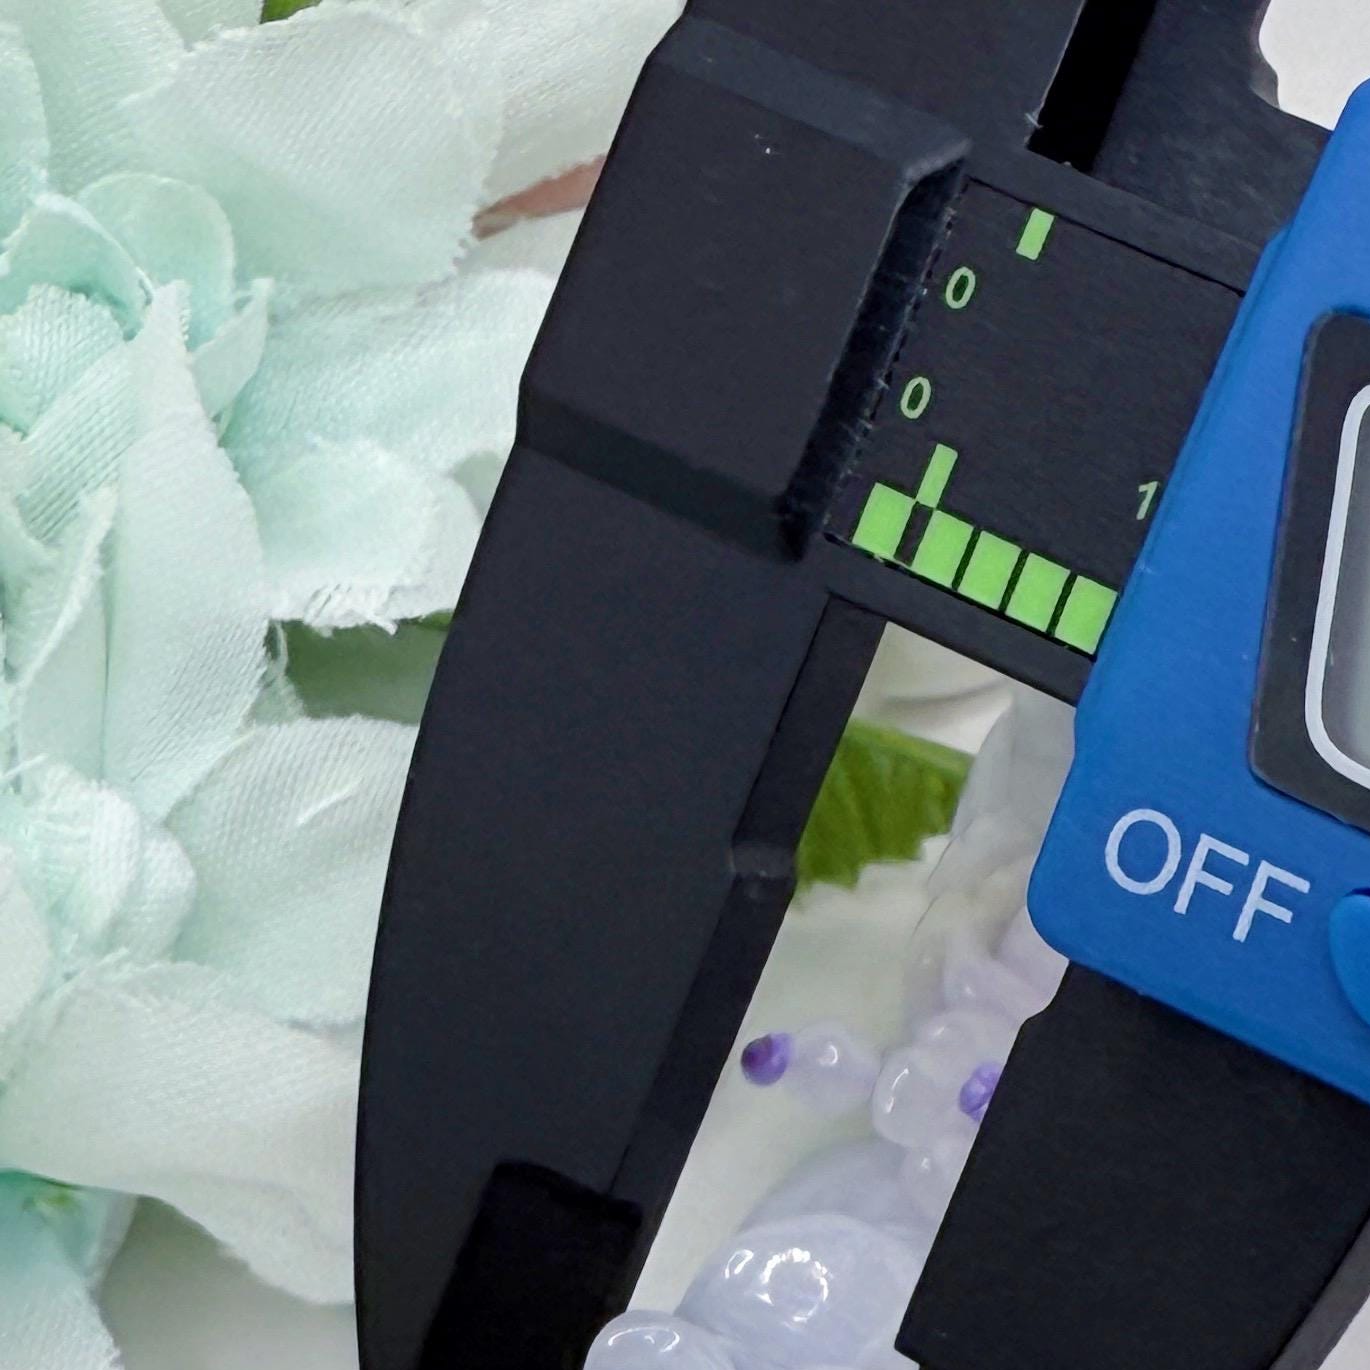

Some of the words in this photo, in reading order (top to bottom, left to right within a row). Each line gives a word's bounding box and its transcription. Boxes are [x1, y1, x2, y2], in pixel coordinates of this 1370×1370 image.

[944, 265, 977, 310] 0
[900, 376, 932, 420] 0
[1104, 807, 1311, 943] OFF
